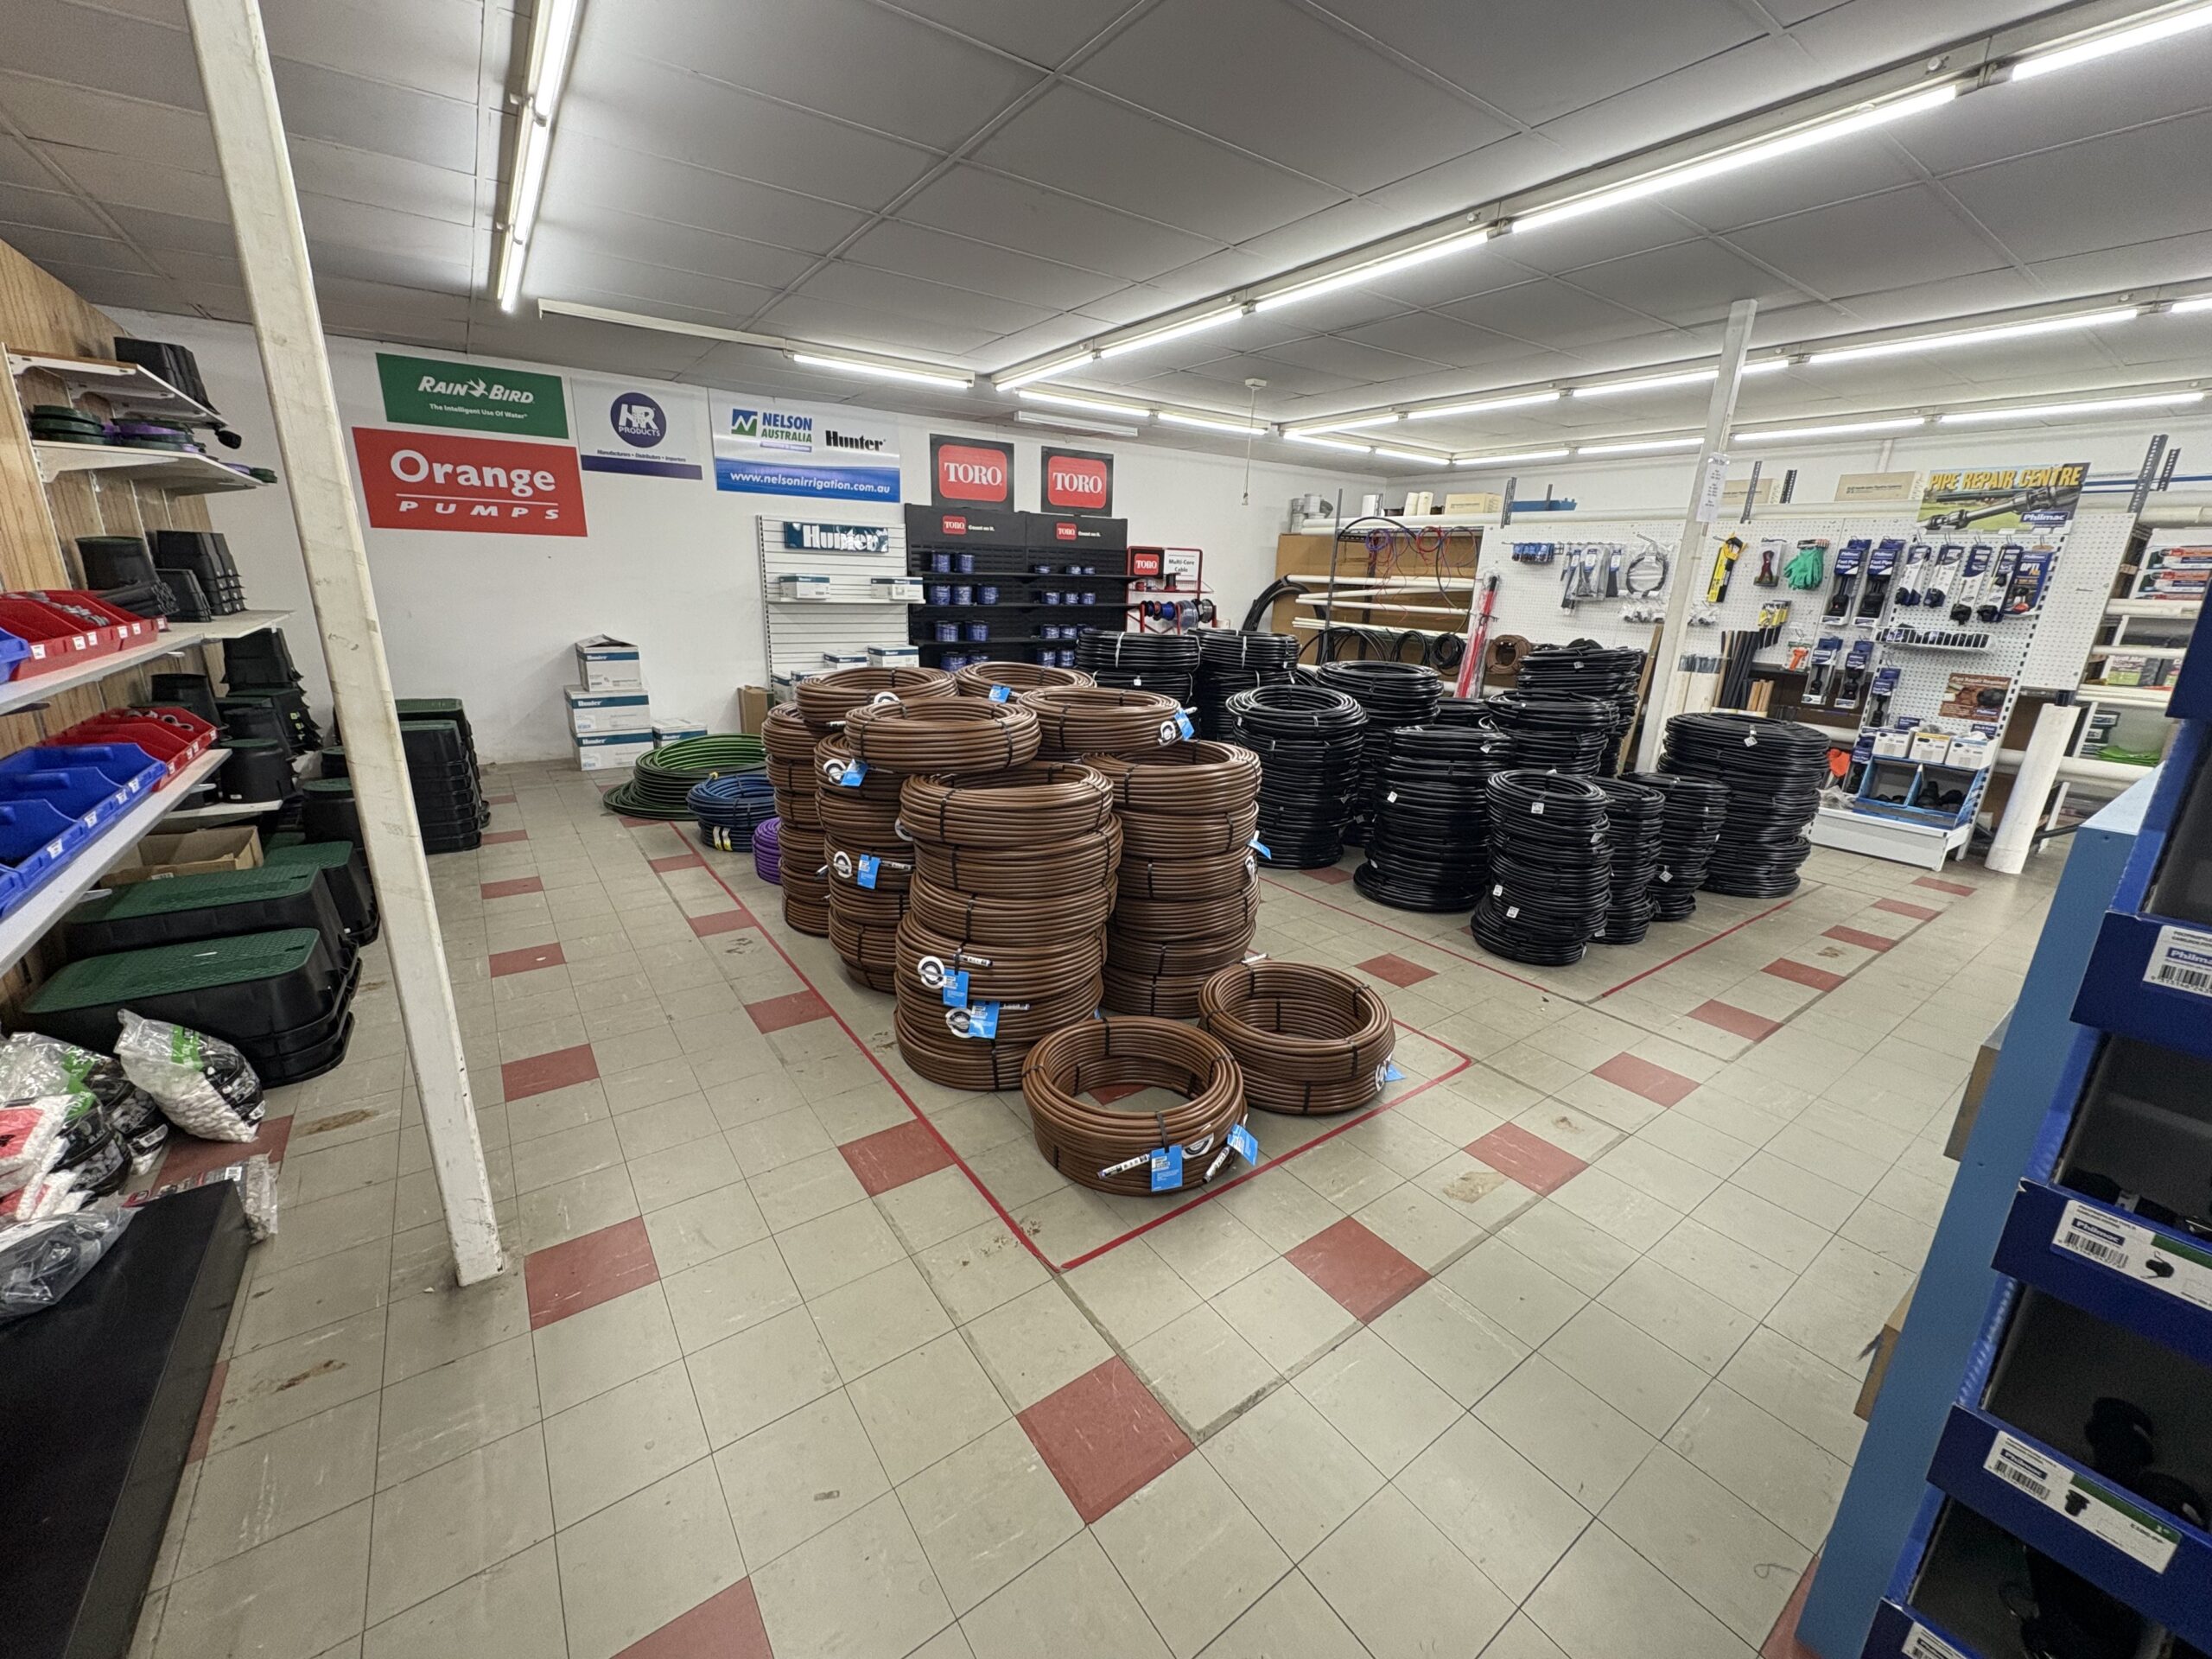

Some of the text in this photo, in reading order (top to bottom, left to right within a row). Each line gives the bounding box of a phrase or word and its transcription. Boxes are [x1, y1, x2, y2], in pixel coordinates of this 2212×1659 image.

[417, 375, 534, 404] RAIN BIRD
[444, 405, 480, 415] Intelligent
[619, 426, 660, 437] PRODUCTS
[762, 412, 813, 431] NELSON
[761, 428, 813, 442] AUSTRALIA
[825, 430, 884, 451] Hunter
[391, 449, 556, 497] Orange
[730, 472, 891, 493] www.nelsonirrigation.com.au
[944, 462, 1002, 486] TORO
[1052, 472, 1103, 493] TORO
[1928, 467, 2083, 491] PIPE REPAIR CENTRE
[398, 501, 559, 519] PUMPS
[1136, 560, 1157, 569] TORO
[2076, 1220, 2120, 1243] Philmac
